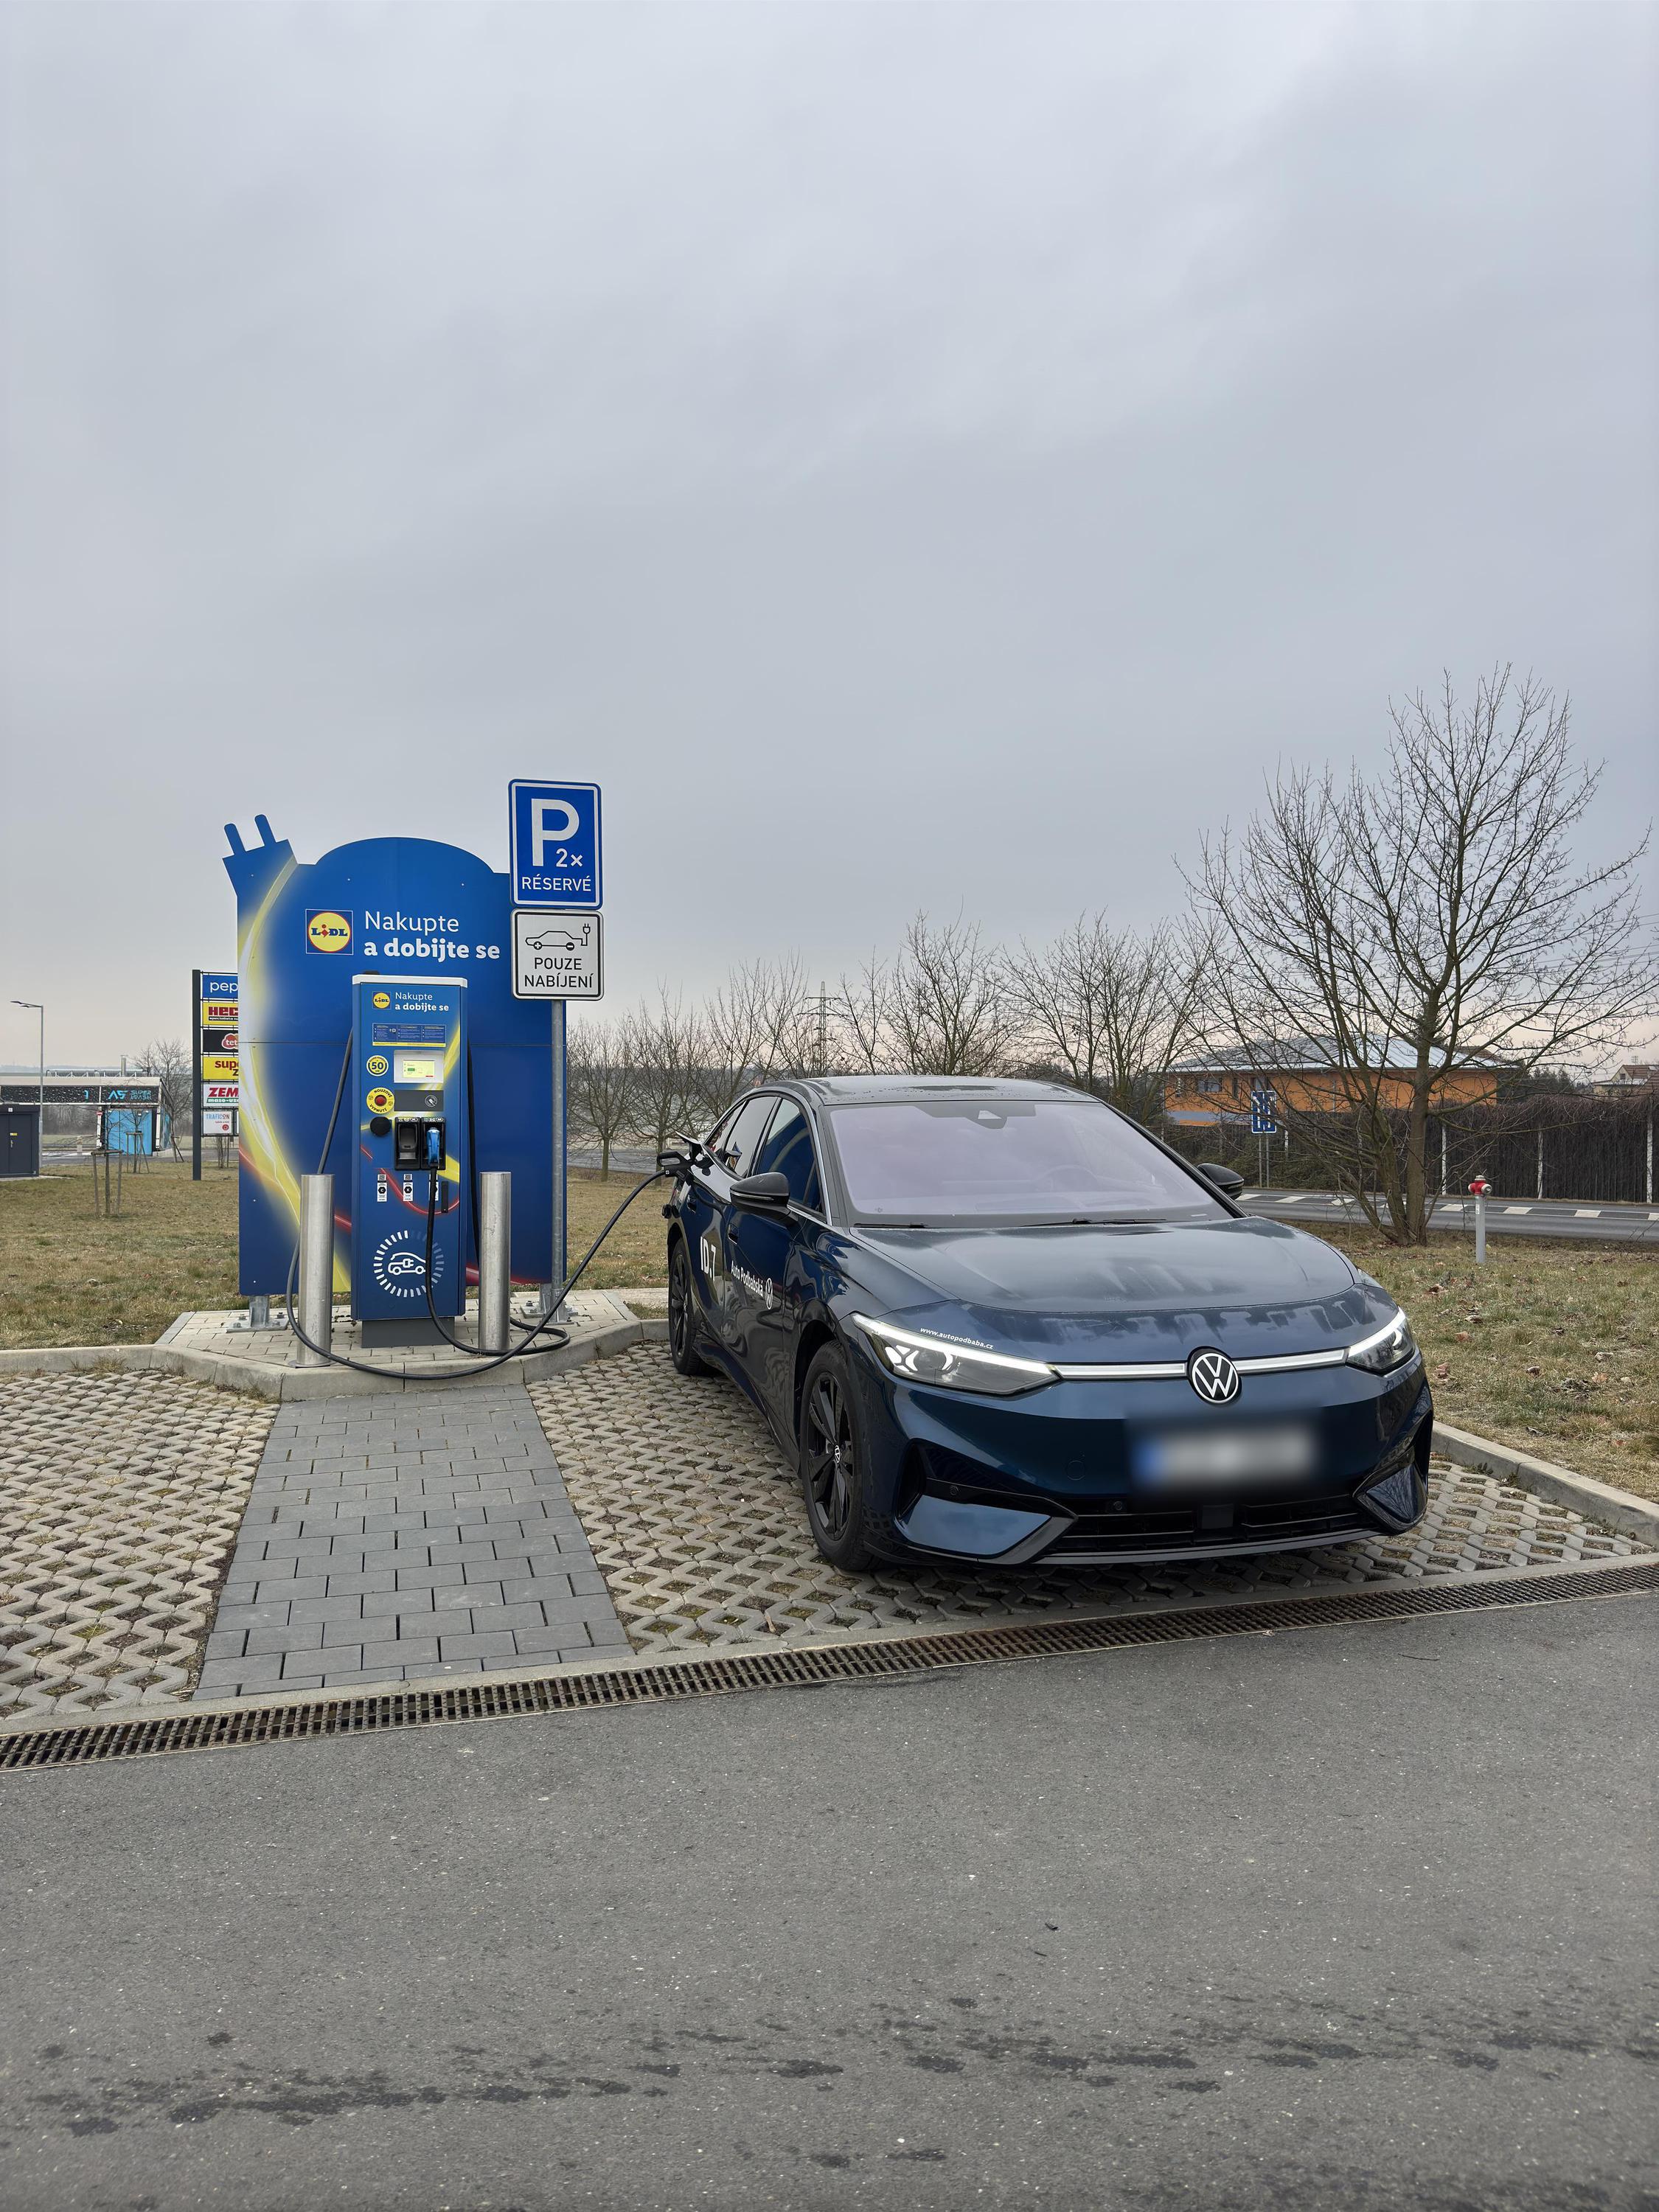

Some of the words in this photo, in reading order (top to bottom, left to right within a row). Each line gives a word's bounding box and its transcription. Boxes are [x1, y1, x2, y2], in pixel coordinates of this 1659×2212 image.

[531, 798, 580, 866] P
[521, 873, 591, 891] RÉSERVÉ
[310, 924, 348, 938] LIDL
[365, 911, 459, 936] Nakupte
[364, 942, 378, 956] a
[383, 937, 469, 962] dobijte
[476, 945, 500, 959] se
[534, 957, 582, 970] POUZE
[524, 972, 594, 989] NABÍJENÍ
[395, 992, 433, 1002] Nakupte
[403, 1003, 437, 1012] dobijte
[215, 1060, 239, 1071] sup
[371, 1062, 383, 1070] 50
[208, 1088, 239, 1097] ZEM
[700, 1236, 716, 1281] ID.7
[731, 1260, 740, 1280] Auto
[920, 1327, 994, 1349] www.autopodbaba.cz
